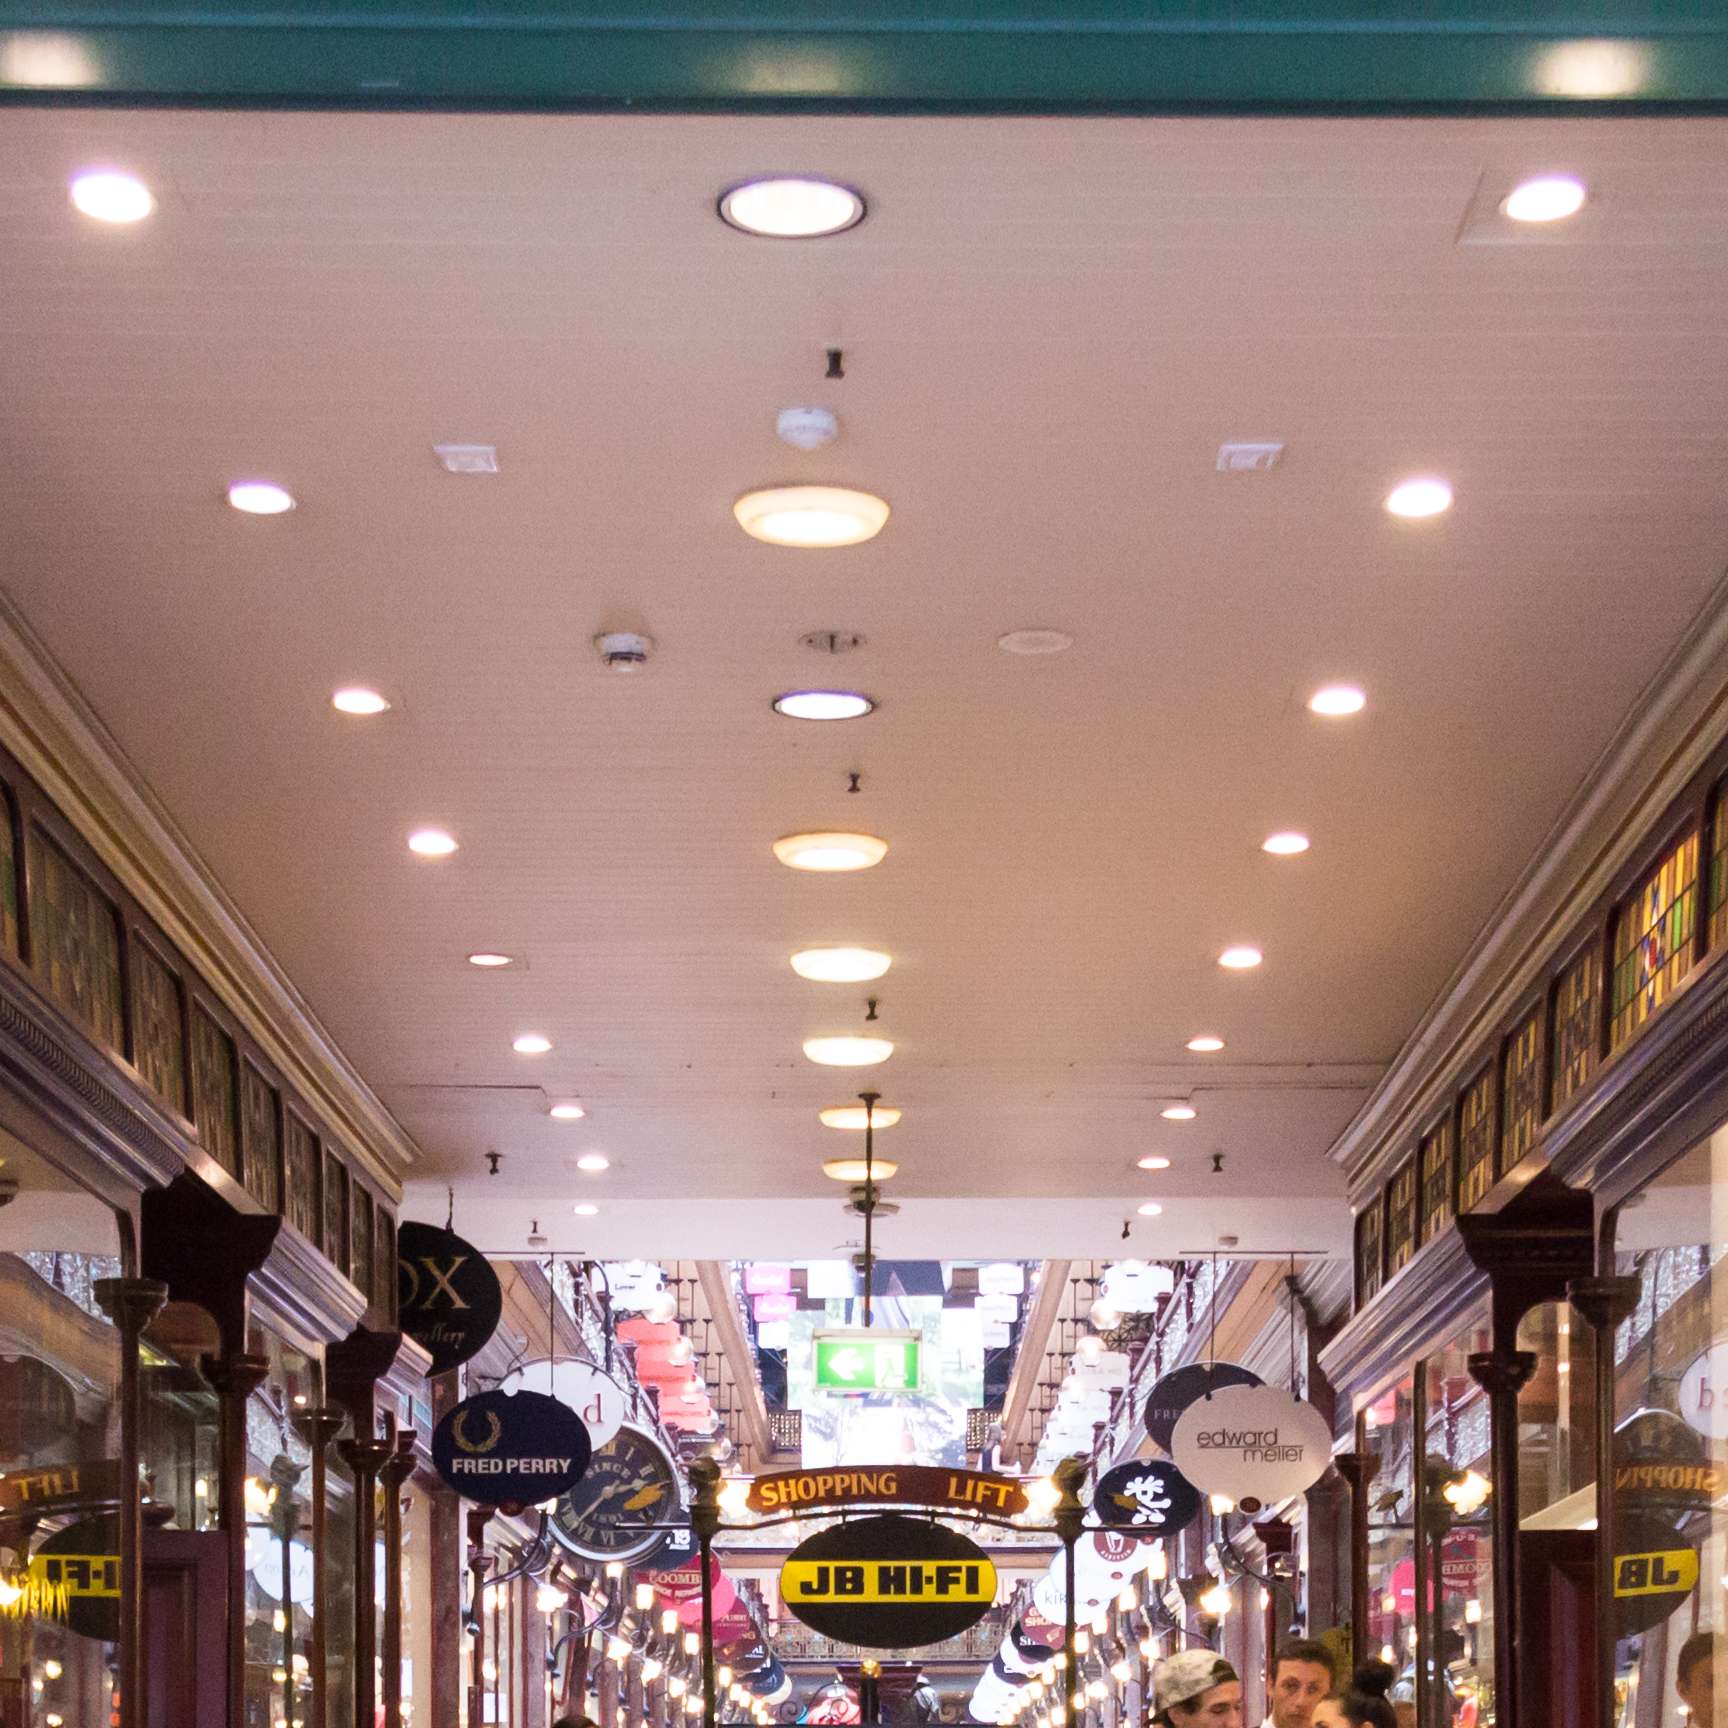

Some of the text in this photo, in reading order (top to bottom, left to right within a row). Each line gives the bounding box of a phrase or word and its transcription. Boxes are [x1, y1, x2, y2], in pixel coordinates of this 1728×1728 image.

[1197, 1428, 1278, 1446] edward
[1243, 1447, 1304, 1463] meller
[452, 1458, 571, 1474] FRED PERRY
[760, 1472, 1014, 1507] SHOPPING LIFT
[649, 1568, 701, 1584] COOMB
[800, 1566, 979, 1595] JB HI-FI
